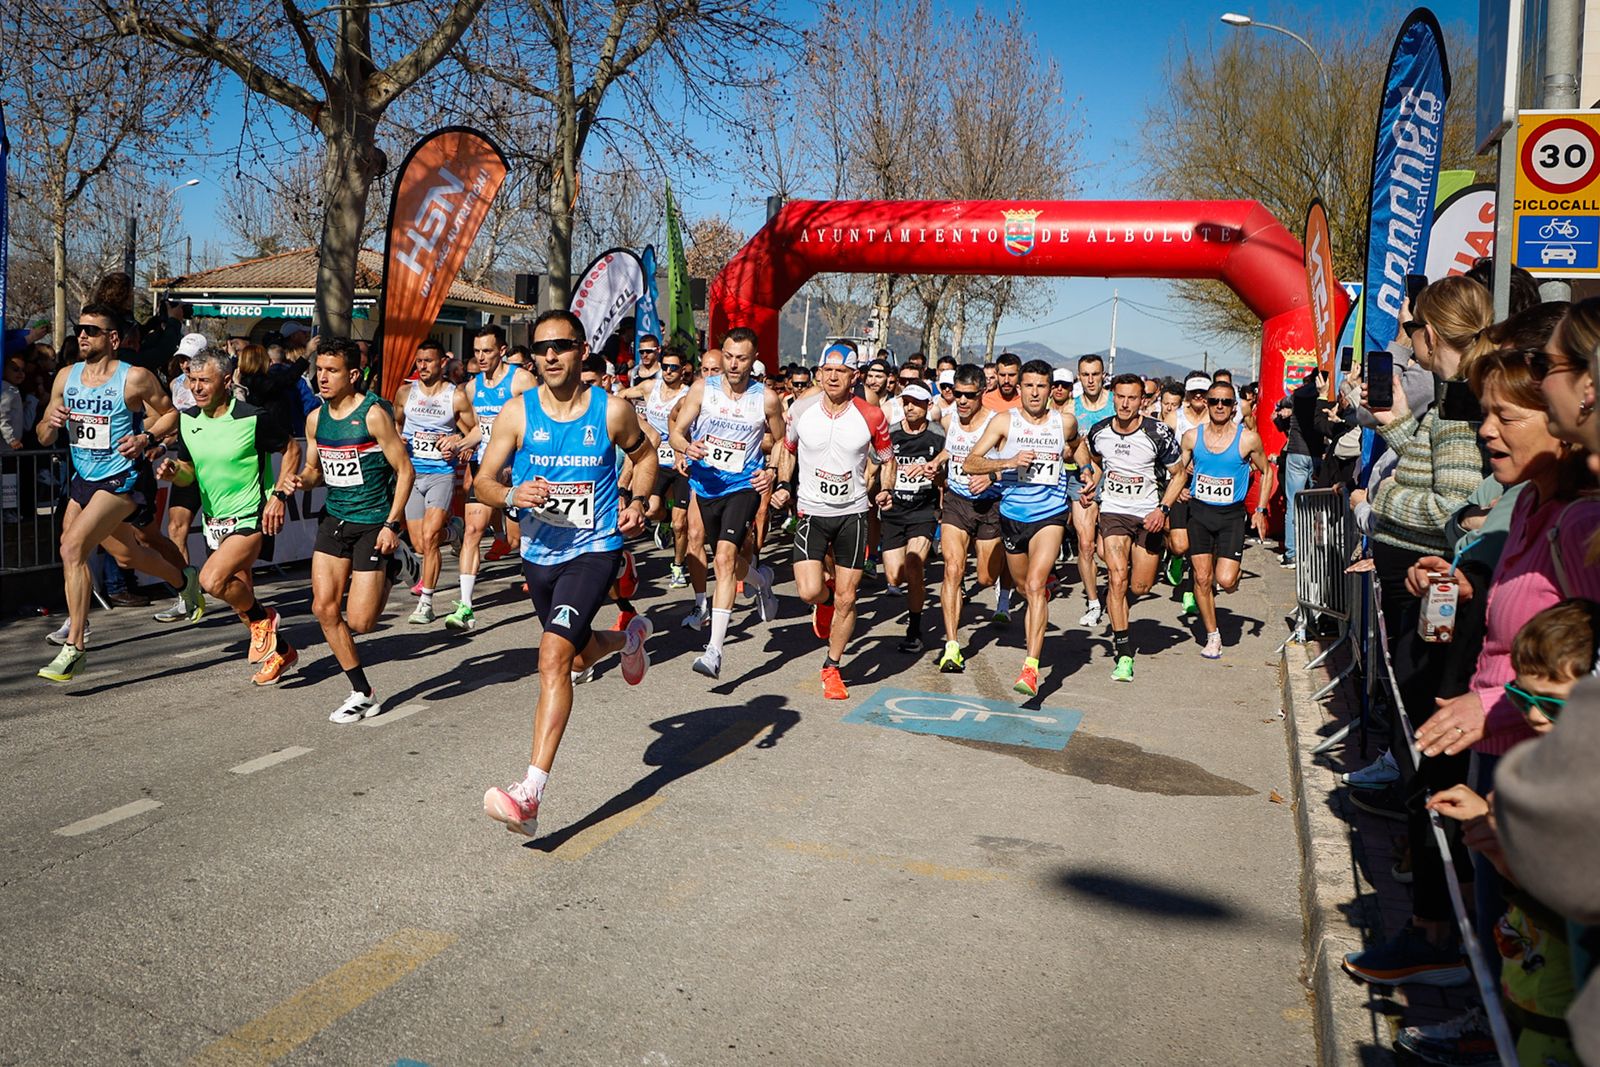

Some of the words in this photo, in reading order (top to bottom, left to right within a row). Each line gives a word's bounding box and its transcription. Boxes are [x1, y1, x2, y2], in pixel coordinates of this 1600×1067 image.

[1539, 144, 1586, 169] 30
[396, 167, 465, 276] HSN
[800, 228, 999, 243] AYUNTAMIENTO
[1041, 228, 1069, 243] DE
[1087, 227, 1231, 243] ALBOLOTE
[220, 306, 262, 316] KIOSCO
[68, 395, 113, 413] nerja
[76, 425, 96, 440] 60
[710, 418, 753, 432] MARACENA
[1016, 437, 1059, 446] MARACENA
[529, 454, 604, 467] TROTASIERRA
[659, 449, 674, 459] 24
[713, 448, 733, 463] 87
[323, 461, 359, 477] 3122
[547, 486, 579, 494] ONDO
[820, 481, 849, 496] 802
[1108, 480, 1143, 495] 3217
[1197, 483, 1232, 497] 3140
[540, 498, 588, 515] 271
